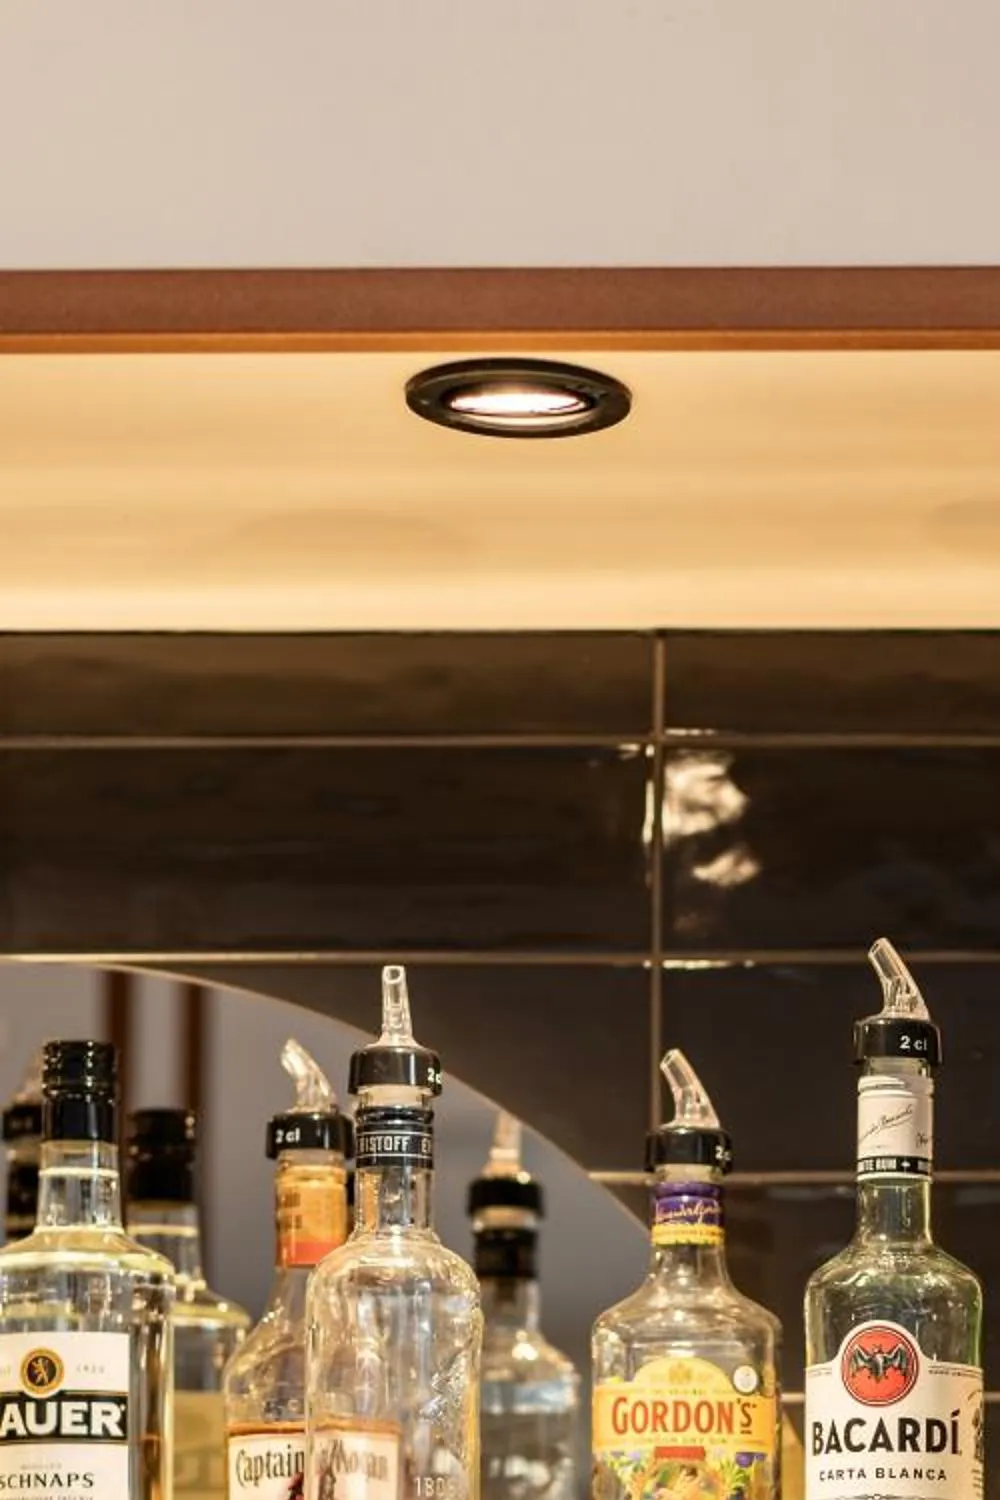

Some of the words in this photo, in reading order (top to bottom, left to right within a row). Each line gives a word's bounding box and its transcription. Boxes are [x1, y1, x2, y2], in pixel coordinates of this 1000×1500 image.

[899, 1035, 910, 1049] 2
[611, 1396, 753, 1435] GORDON'S
[812, 1408, 960, 1456] BACARDÍ
[0, 1472, 95, 1490] SCHNAPS
[819, 1468, 867, 1482] CARTA
[875, 1467, 948, 1481] BLANCA
